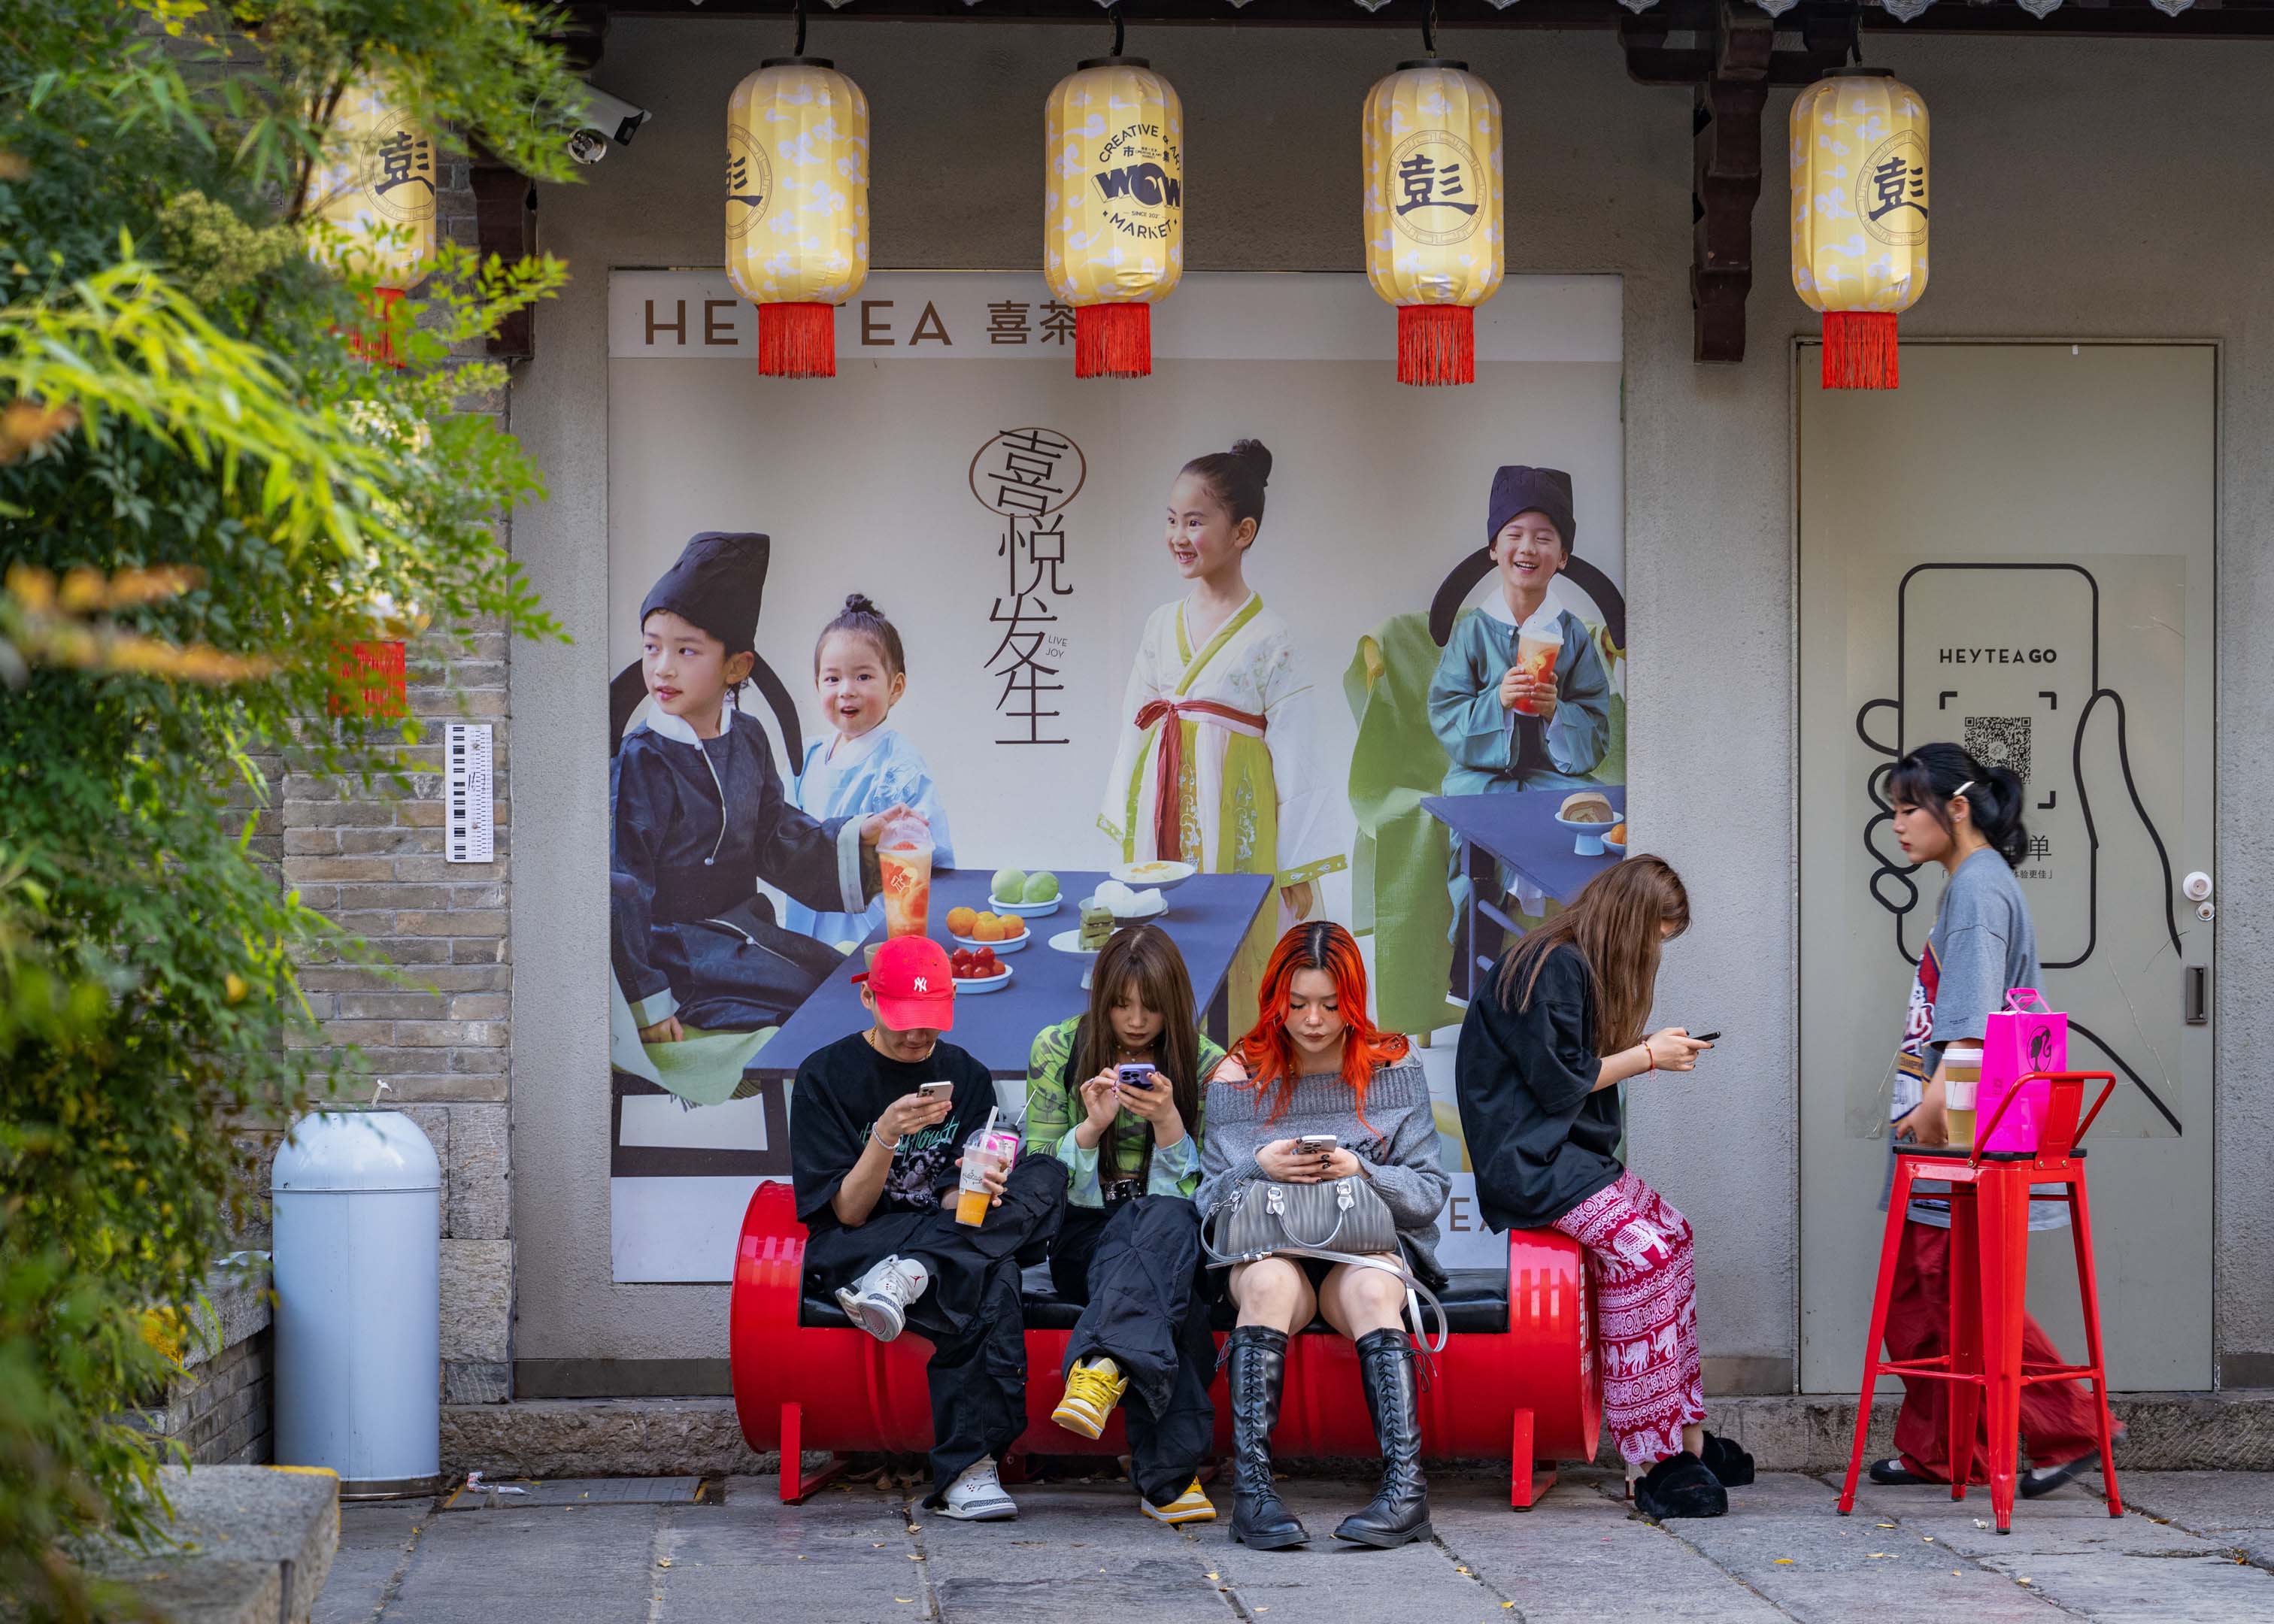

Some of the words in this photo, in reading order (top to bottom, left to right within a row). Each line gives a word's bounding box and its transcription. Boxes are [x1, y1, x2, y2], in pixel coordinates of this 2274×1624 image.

[374, 130, 435, 196] 彭
[1099, 123, 1159, 162] CREATIVE
[1090, 162, 1181, 210] WOW
[1396, 153, 1479, 217] 彭
[1868, 156, 1928, 221] 彭
[1109, 212, 1172, 240] MARKET
[644, 299, 953, 346] HEEA
[987, 299, 1077, 346] 喜茶
[984, 429, 1075, 744] 喜悦发生
[1045, 647, 1065, 659] JOY
[1048, 635, 1069, 647] LIVE
[914, 976, 927, 992] NY
